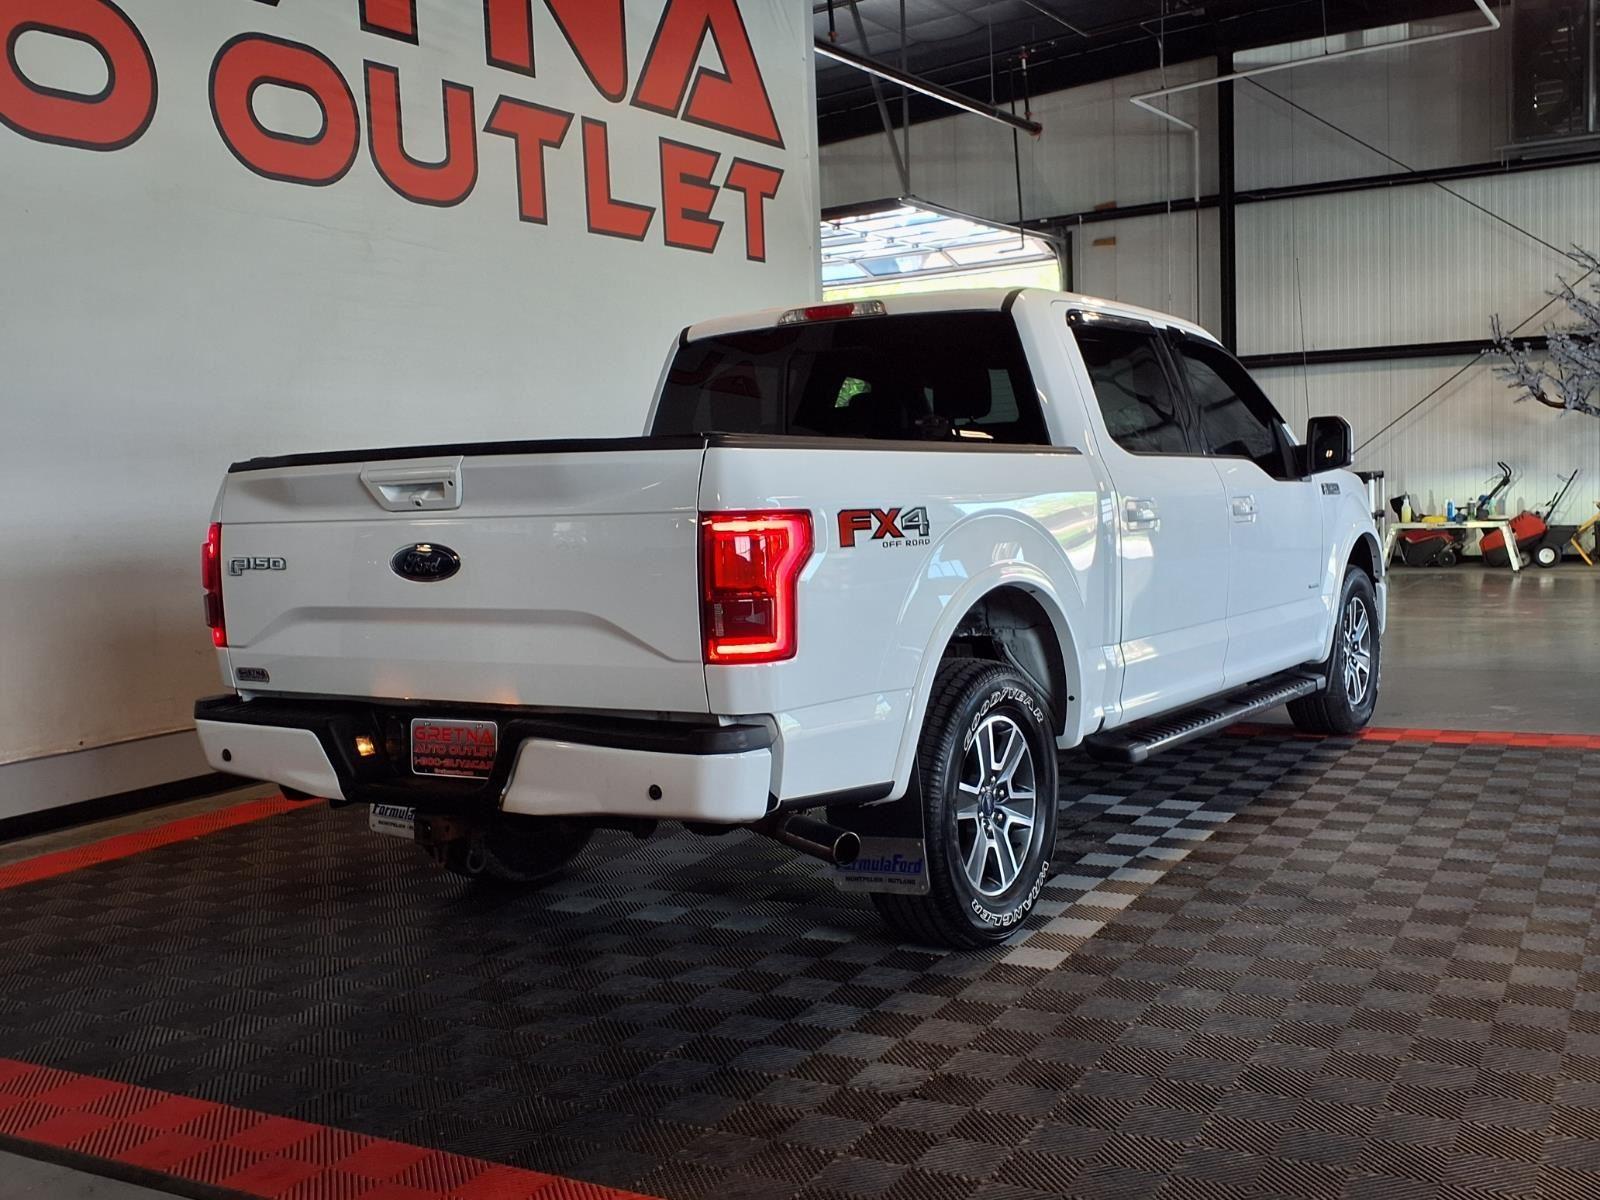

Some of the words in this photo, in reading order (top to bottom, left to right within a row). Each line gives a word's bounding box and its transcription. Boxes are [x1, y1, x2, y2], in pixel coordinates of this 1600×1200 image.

[209, 32, 785, 262] OUTLET
[837, 506, 930, 548] FX4
[882, 541, 902, 549] OFF
[905, 538, 931, 547] ROAD
[414, 726, 494, 745] GRETNA
[963, 686, 1044, 752] GOODYEAR
[415, 743, 447, 754] AUTO
[450, 745, 495, 757] OUTLET
[971, 861, 1050, 927] WRANGLER
